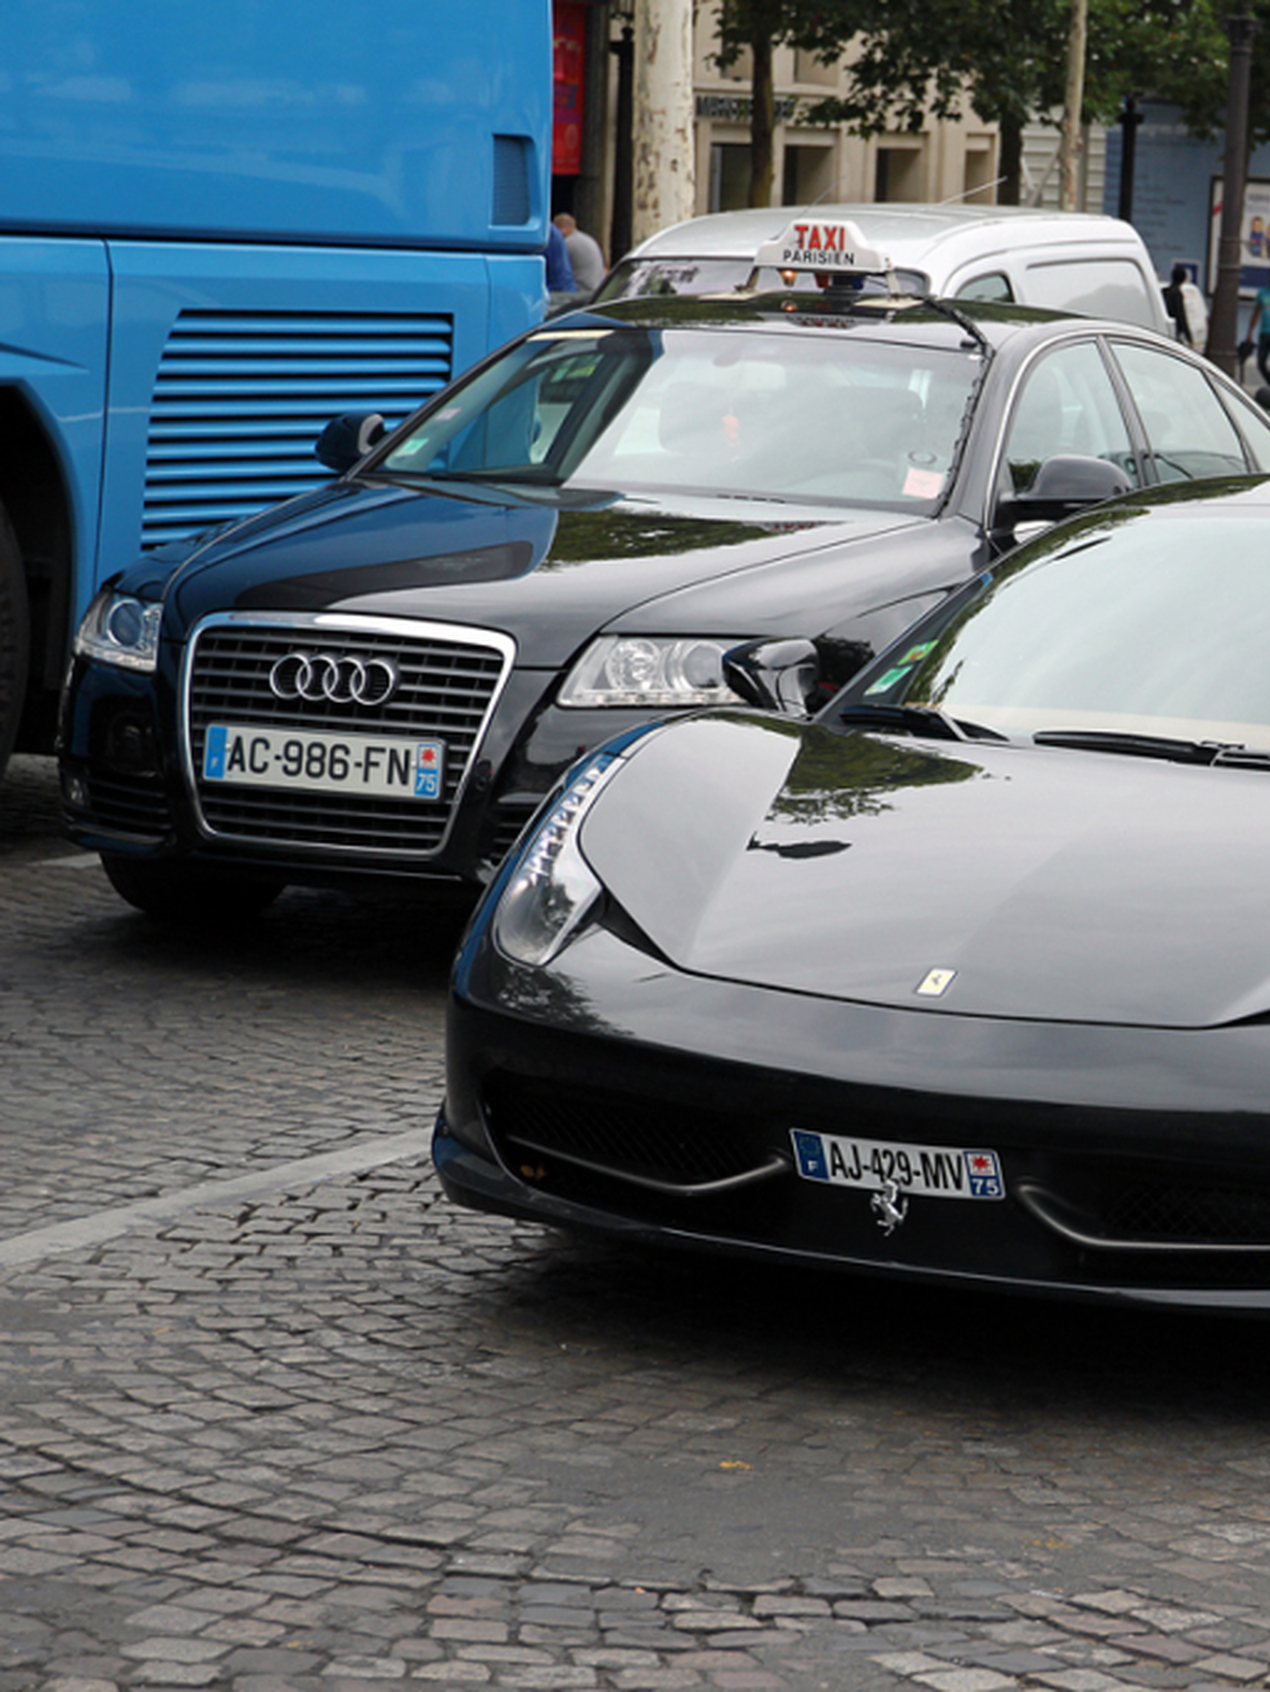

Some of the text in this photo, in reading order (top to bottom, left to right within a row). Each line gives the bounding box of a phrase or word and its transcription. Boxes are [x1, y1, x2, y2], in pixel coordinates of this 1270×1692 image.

[783, 250, 855, 265] PARISIEN
[794, 225, 845, 251] TAXI
[227, 735, 412, 786] AC-986-FN
[415, 773, 438, 793] 75
[807, 1141, 999, 1195] F AJ-429-MV 75
